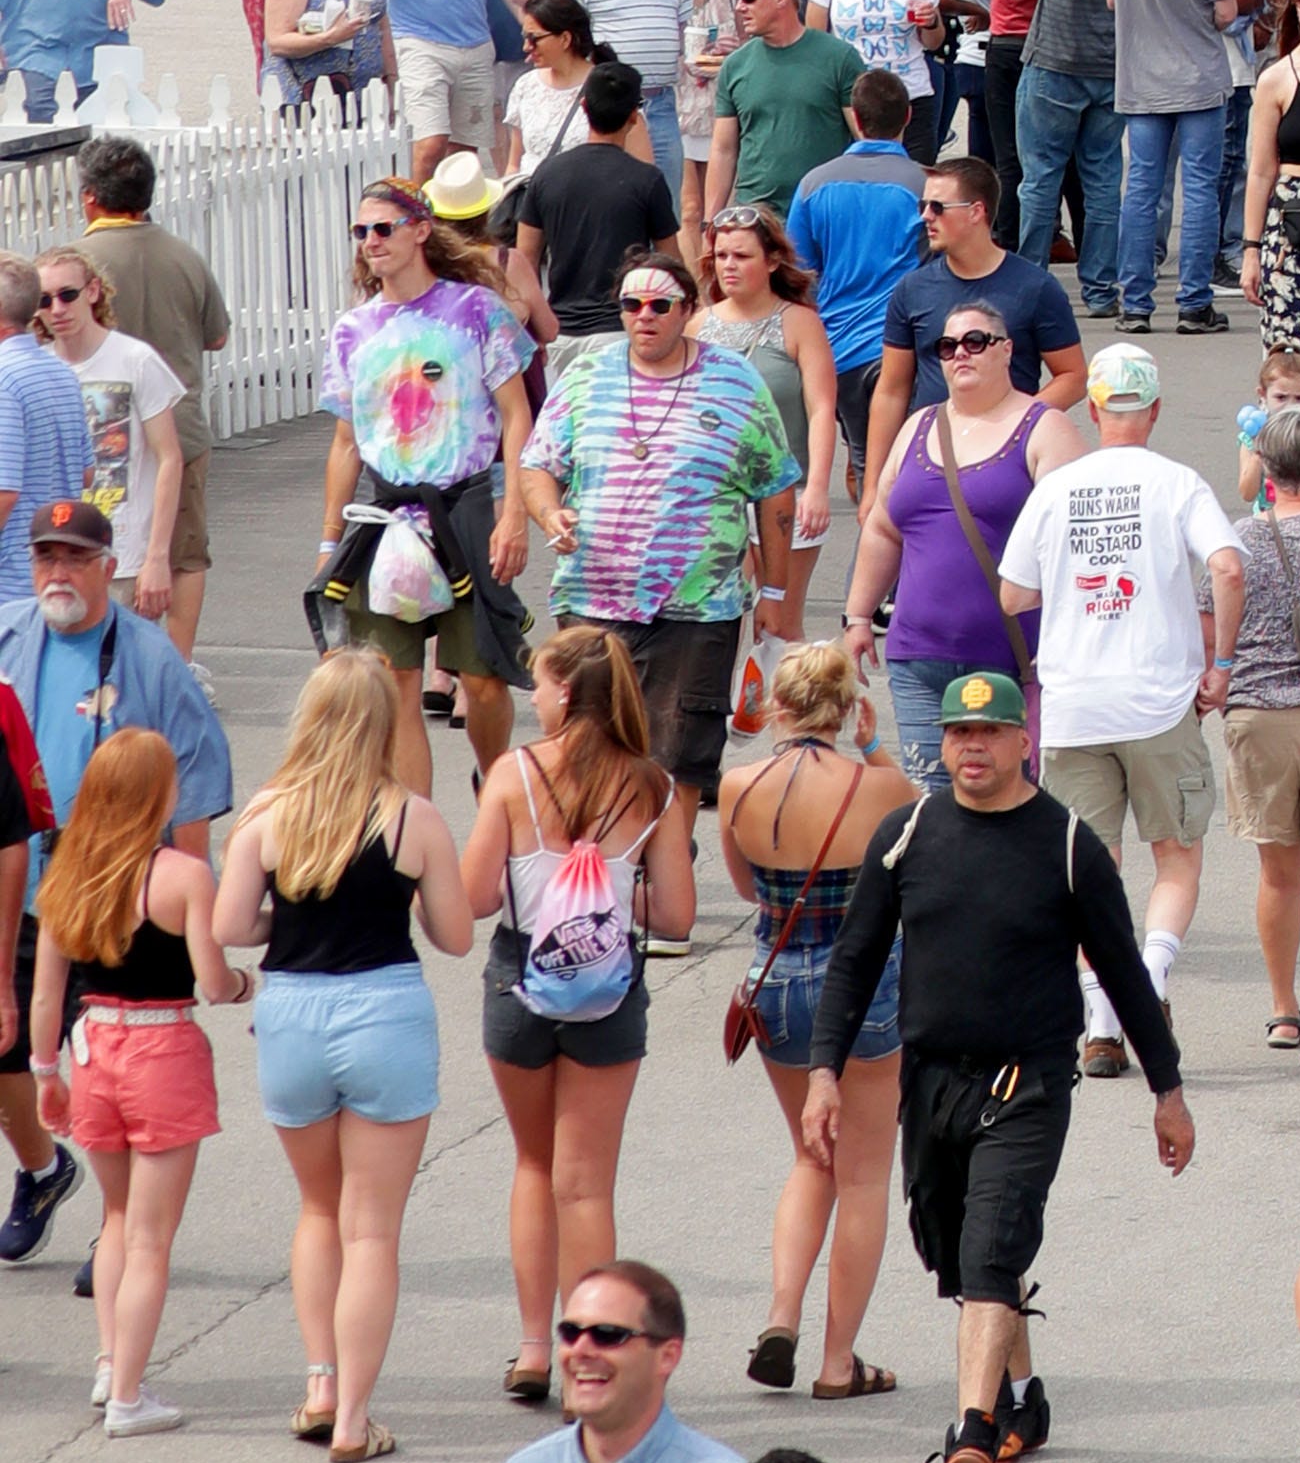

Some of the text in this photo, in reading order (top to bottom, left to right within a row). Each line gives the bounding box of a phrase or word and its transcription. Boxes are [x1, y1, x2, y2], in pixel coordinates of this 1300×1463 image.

[1069, 484, 1141, 499] KEEP YOUR
[1069, 496, 1140, 517] BUNS WARM
[1069, 522, 1142, 538] AND YOUR
[1070, 534, 1142, 555] MUSTARD
[1089, 555, 1127, 566] COOL
[1086, 599, 1131, 616] RIGHT
